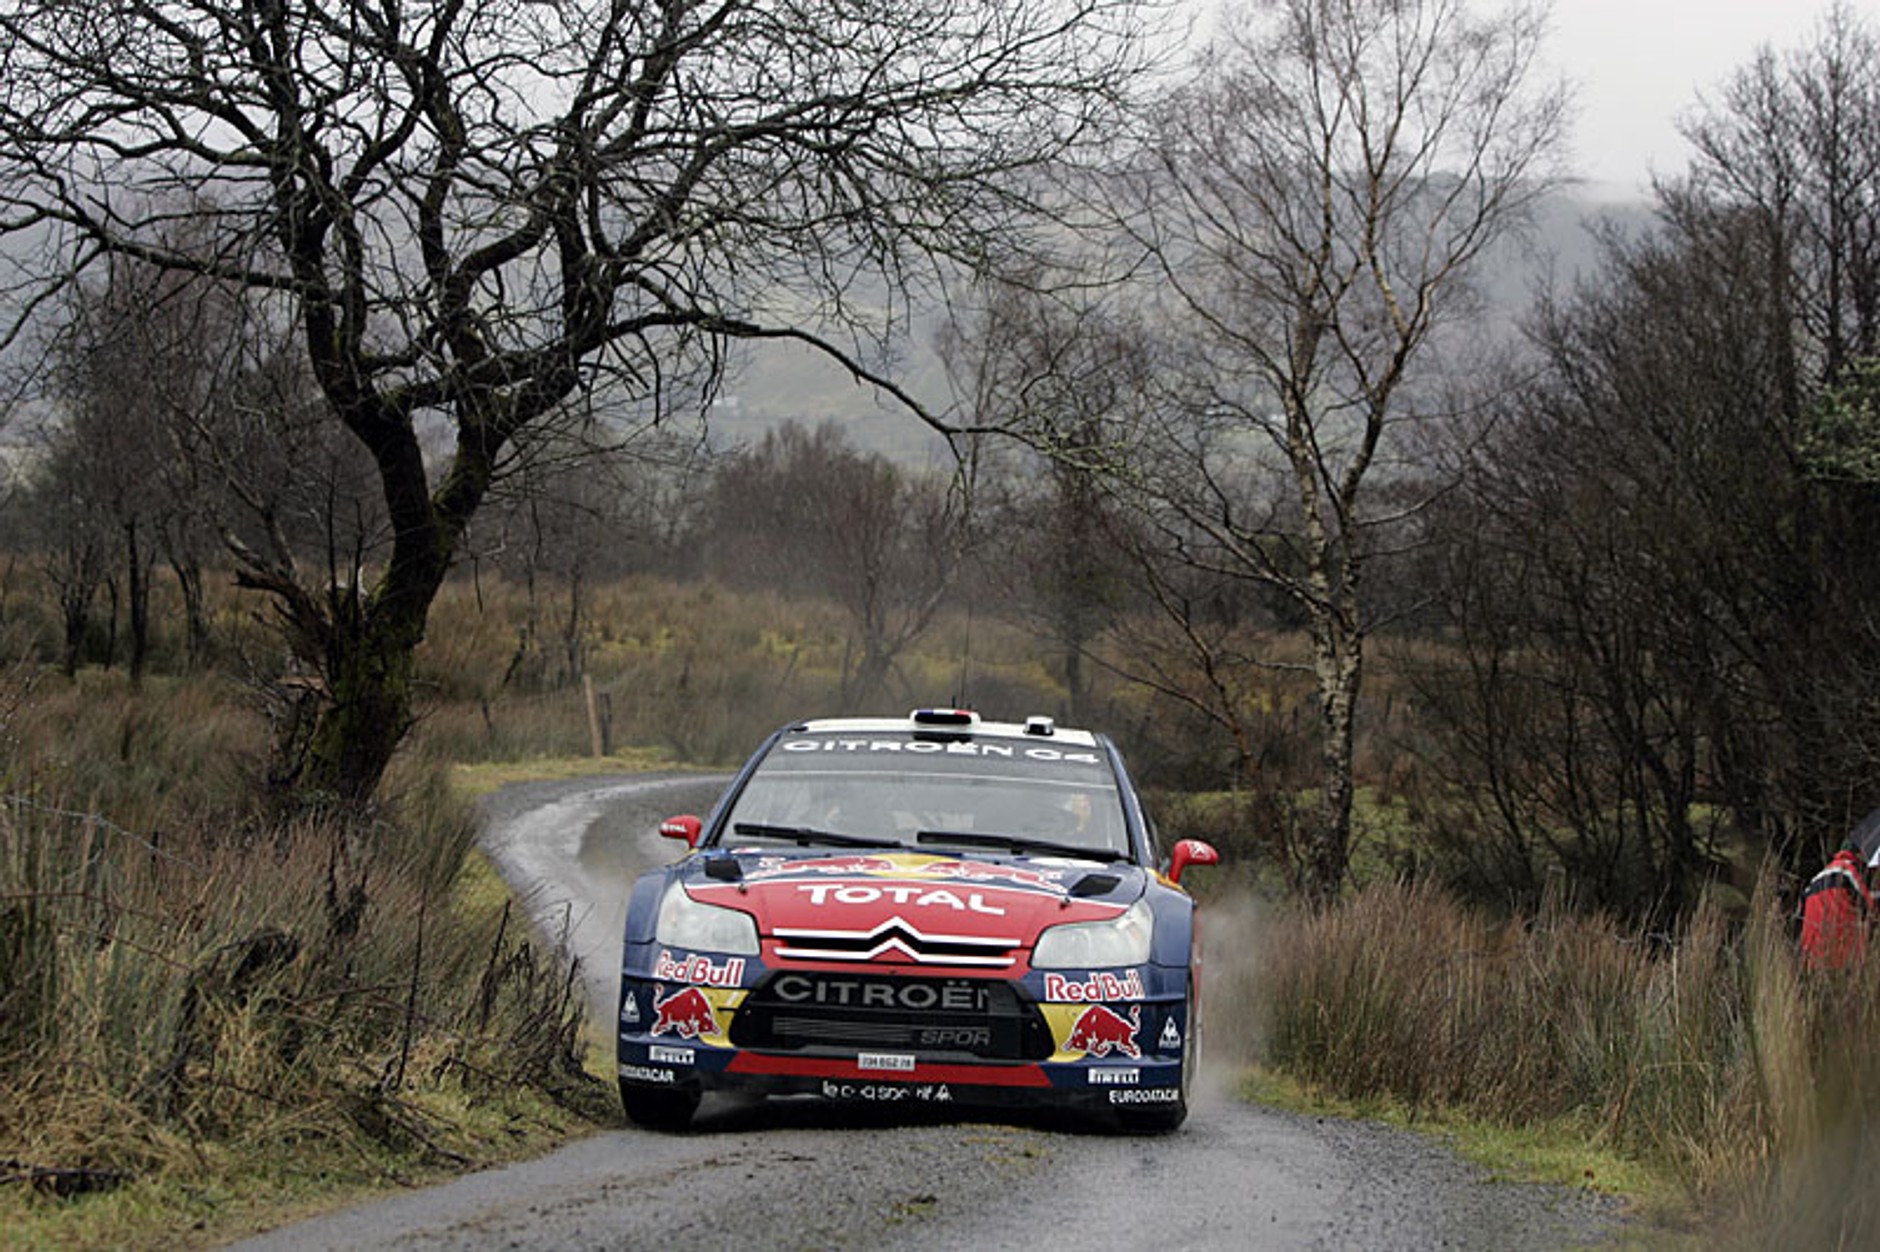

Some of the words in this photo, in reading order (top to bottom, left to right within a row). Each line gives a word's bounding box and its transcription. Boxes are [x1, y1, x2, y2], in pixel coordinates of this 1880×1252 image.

[783, 740, 1013, 756] CITROËN
[1025, 748, 1100, 763] C4
[797, 883, 1006, 915] TOTAL
[654, 949, 692, 981] Red
[689, 957, 745, 987] Bull
[1044, 971, 1102, 1001] Red
[1101, 968, 1145, 999] Bull
[1088, 1067, 1141, 1085] PIRELLI
